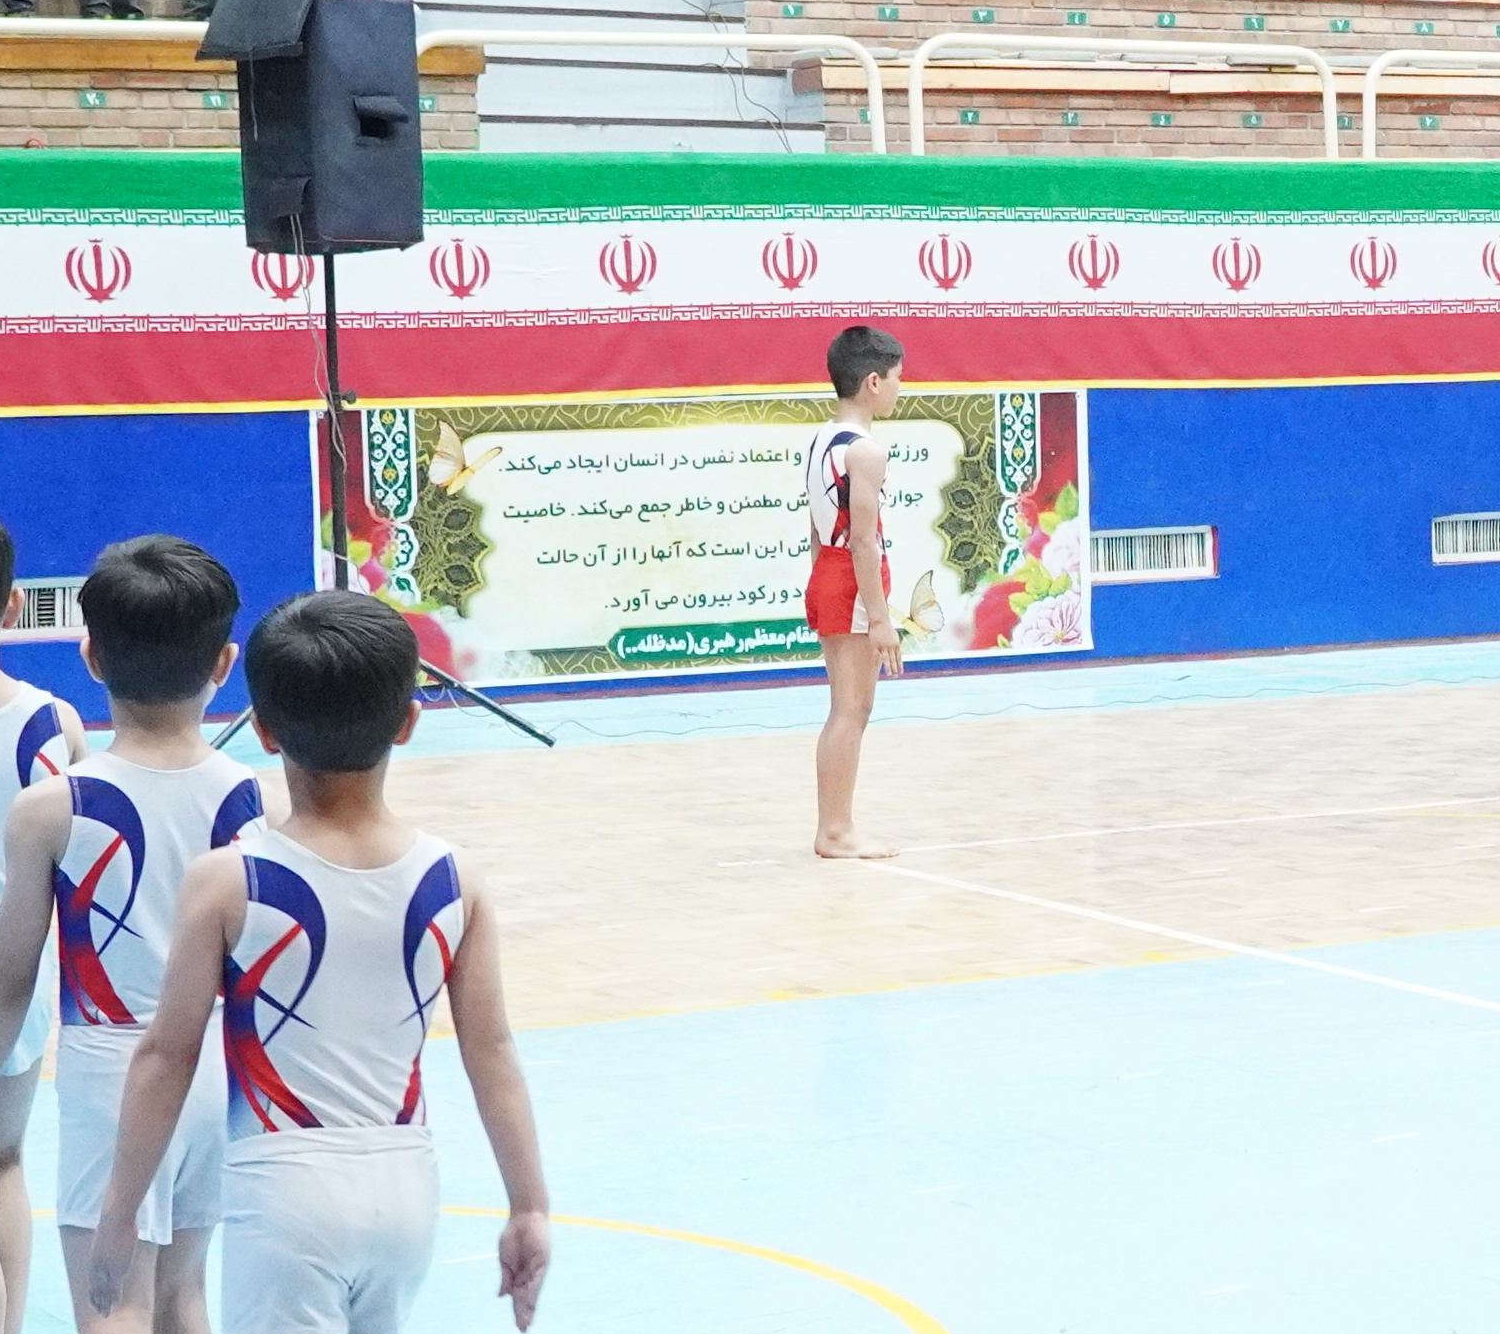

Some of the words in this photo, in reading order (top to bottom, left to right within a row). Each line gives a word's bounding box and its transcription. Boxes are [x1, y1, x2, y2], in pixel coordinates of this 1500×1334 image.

[566, 454, 610, 474] ایجاد
[614, 452, 664, 472] انسان
[669, 454, 689, 470] در
[693, 450, 734, 470] نفس
[739, 448, 789, 465] اعتماد
[793, 452, 803, 466] و
[502, 502, 566, 524] خاصیت
[637, 502, 672, 523] جمع
[675, 496, 713, 516] خاطر
[716, 500, 725, 514] و
[729, 494, 782, 514] مطمئن
[536, 547, 579, 565] حالت
[583, 543, 608, 567] آن
[612, 546, 627, 566] از
[632, 546, 647, 565] را
[651, 540, 682, 563] آنها
[685, 541, 707, 558] که
[711, 541, 750, 557] است
[755, 539, 784, 559] این
[683, 590, 732, 609] بیرون
[736, 585, 776, 605] رکود
